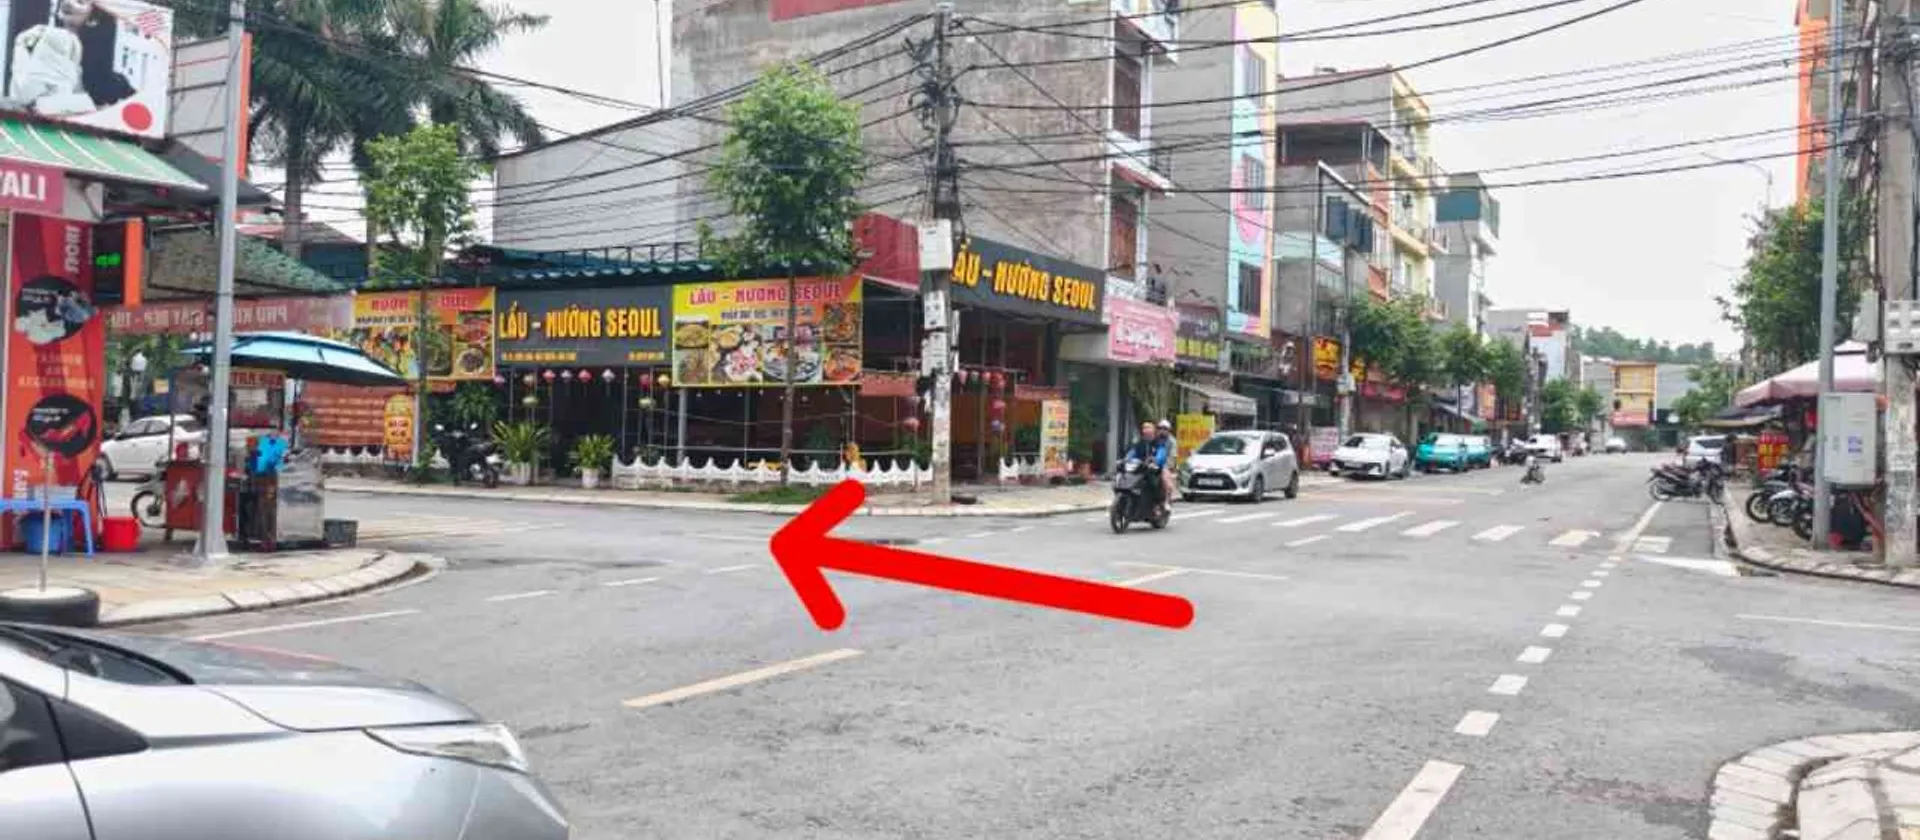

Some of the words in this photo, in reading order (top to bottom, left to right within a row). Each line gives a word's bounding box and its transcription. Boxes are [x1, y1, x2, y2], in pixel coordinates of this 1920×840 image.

[0, 169, 47, 202] ALI
[1052, 275, 1096, 311] SEOUL
[606, 308, 661, 337] SEOUL
